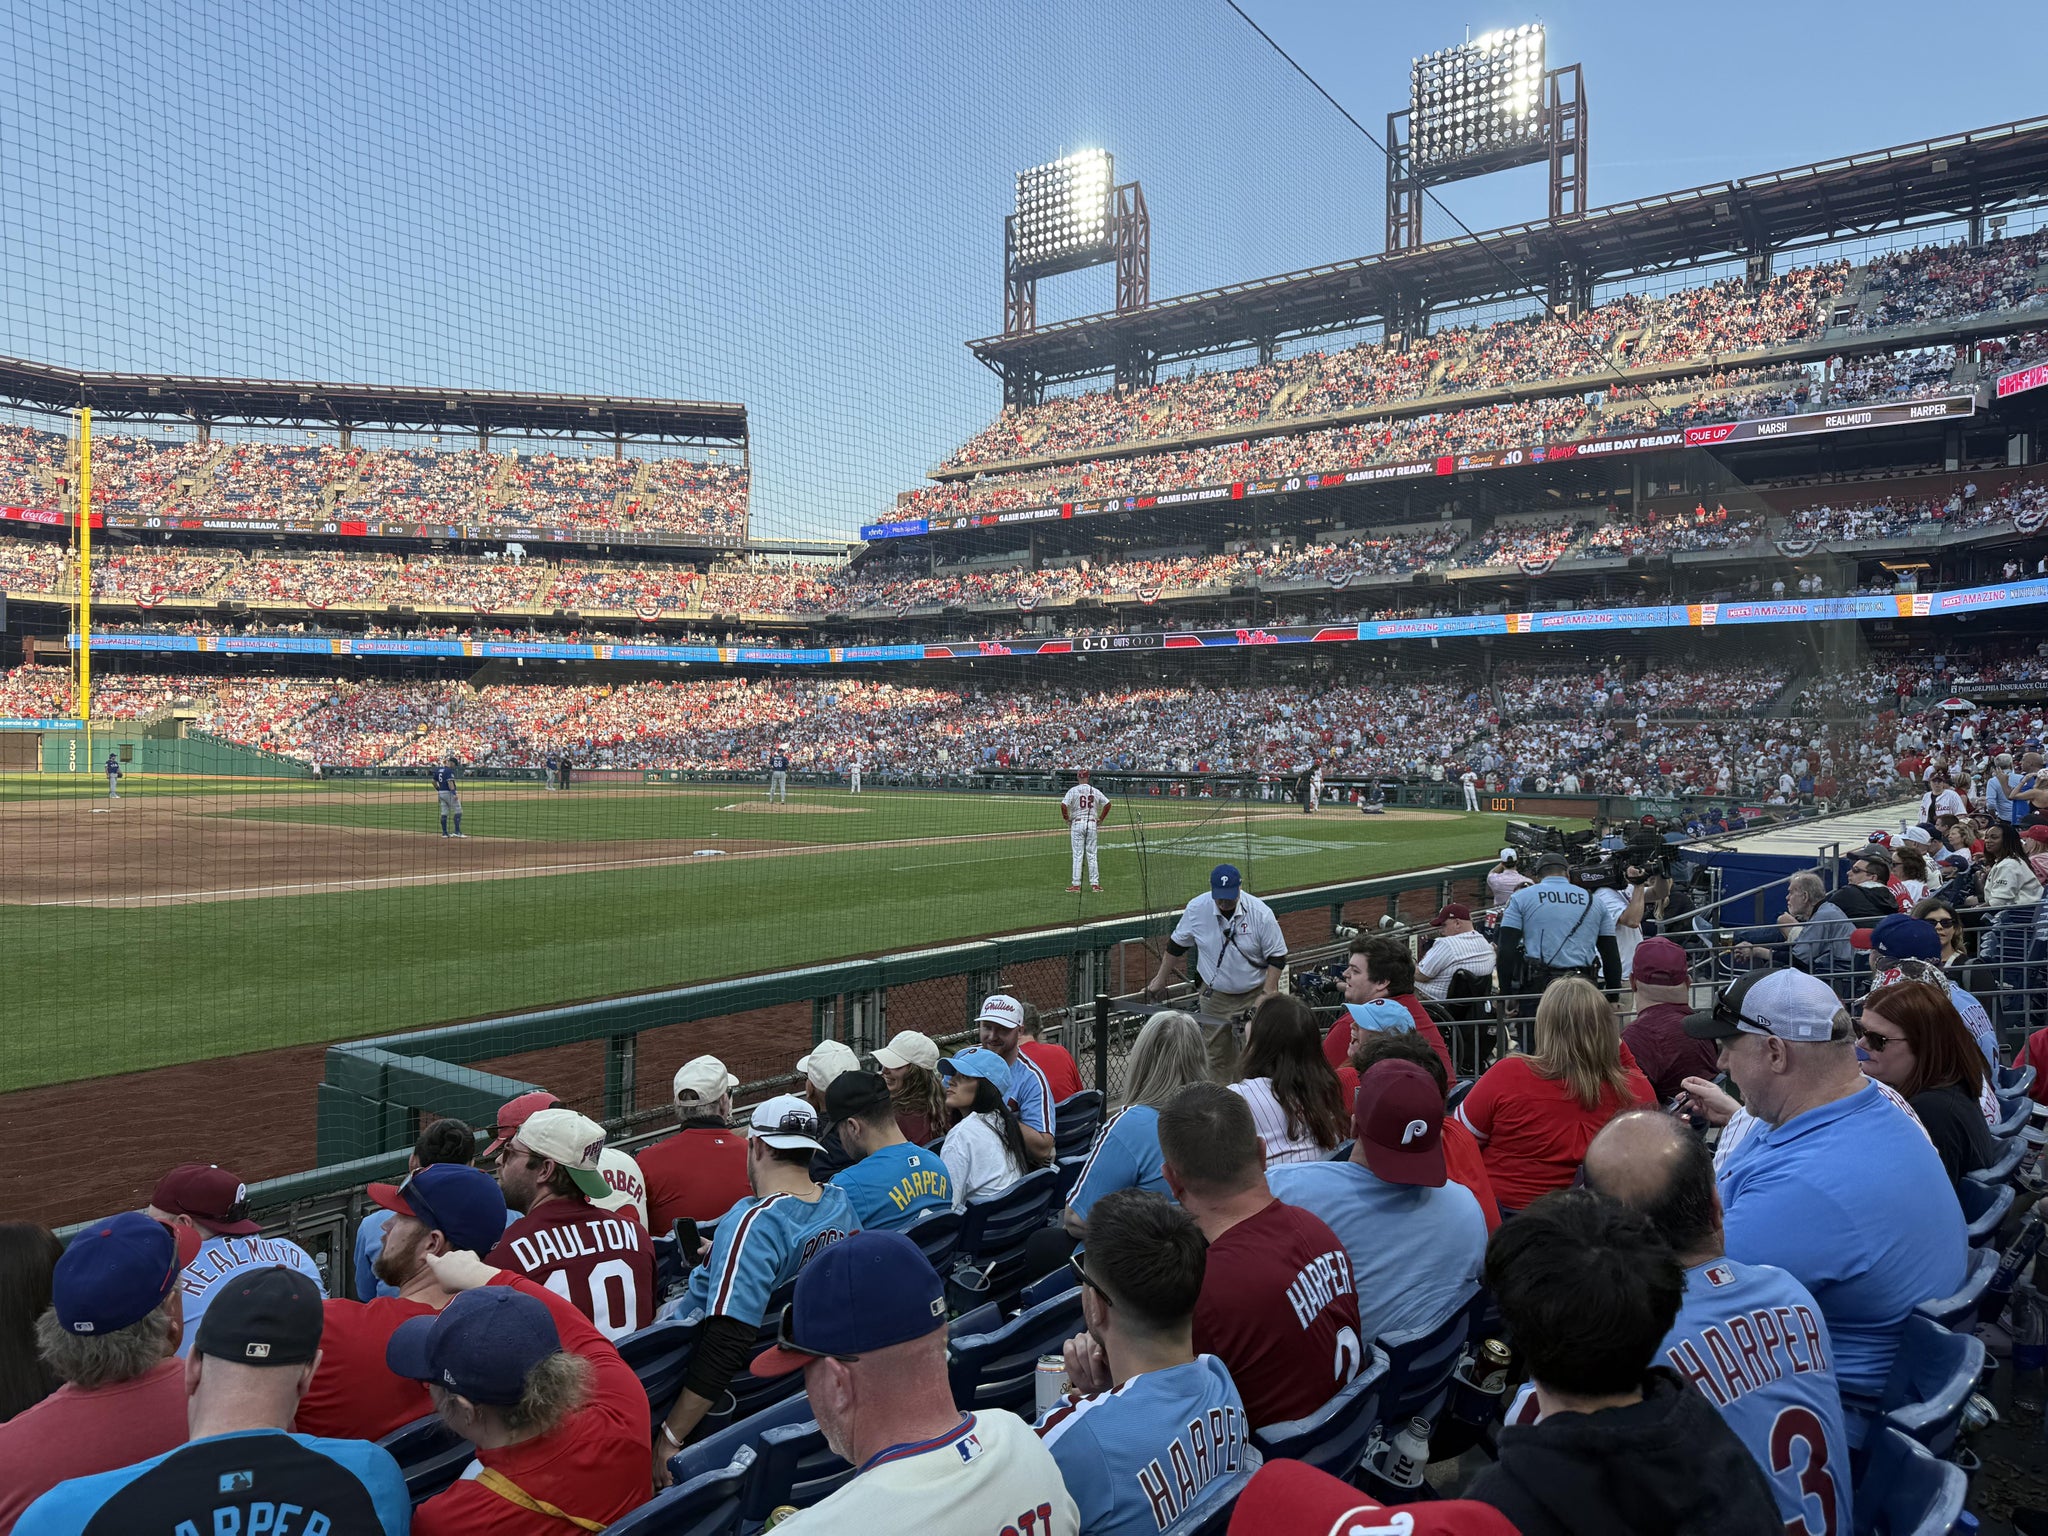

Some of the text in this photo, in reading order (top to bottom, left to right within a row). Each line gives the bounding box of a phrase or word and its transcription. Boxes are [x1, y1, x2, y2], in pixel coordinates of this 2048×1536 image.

[1690, 403, 1947, 442] DUE UP MARSH REALMUTO HARPER
[1578, 441, 1612, 455] GAME
[1613, 439, 1638, 452] DAY
[1639, 433, 1683, 448] READY.
[1506, 450, 1523, 464] 10
[1346, 470, 1375, 482] GAME
[1376, 467, 1395, 479] DAY
[1396, 463, 1433, 476] READY.
[1288, 478, 1300, 490] 10
[1157, 493, 1181, 505] GAME
[1181, 491, 1198, 502] DAY
[1199, 488, 1229, 499] READY.
[1108, 499, 1119, 511] 10
[148, 517, 161, 528] 10
[999, 513, 1019, 523] GAME
[1020, 511, 1034, 521] DAY
[1034, 508, 1060, 519] READY.
[203, 520, 230, 529] GAME
[230, 521, 248, 529] DAY
[249, 521, 280, 530] READY.
[325, 523, 336, 532] 10
[957, 518, 967, 528] 10
[1962, 590, 2006, 605] AMAZING
[1754, 604, 1807, 616] AMAZING
[1566, 612, 1613, 625] AMAZING
[1397, 622, 1439, 633] AMAZING
[1113, 637, 1129, 647] OUTS
[1958, 681, 2048, 693] PHILADELPHIA INSURANCE CLU
[1079, 795, 1095, 809] 62
[1492, 798, 1515, 811] 007
[1221, 875, 1229, 887] P
[1538, 892, 1586, 905] POLICE
[1883, 968, 1901, 986] P
[985, 1002, 1015, 1014] Phillies
[1401, 1119, 1428, 1145] P
[603, 1169, 644, 1204] RBER
[889, 1170, 947, 1211] HARPER
[510, 1219, 639, 1273] DAULTON
[182, 1237, 302, 1297] REALMUTO
[1286, 1250, 1353, 1331] HARPER
[1666, 1304, 1827, 1408] HARPER
[1136, 1406, 1250, 1533] HARPER
[1768, 1404, 1838, 1536] 3
